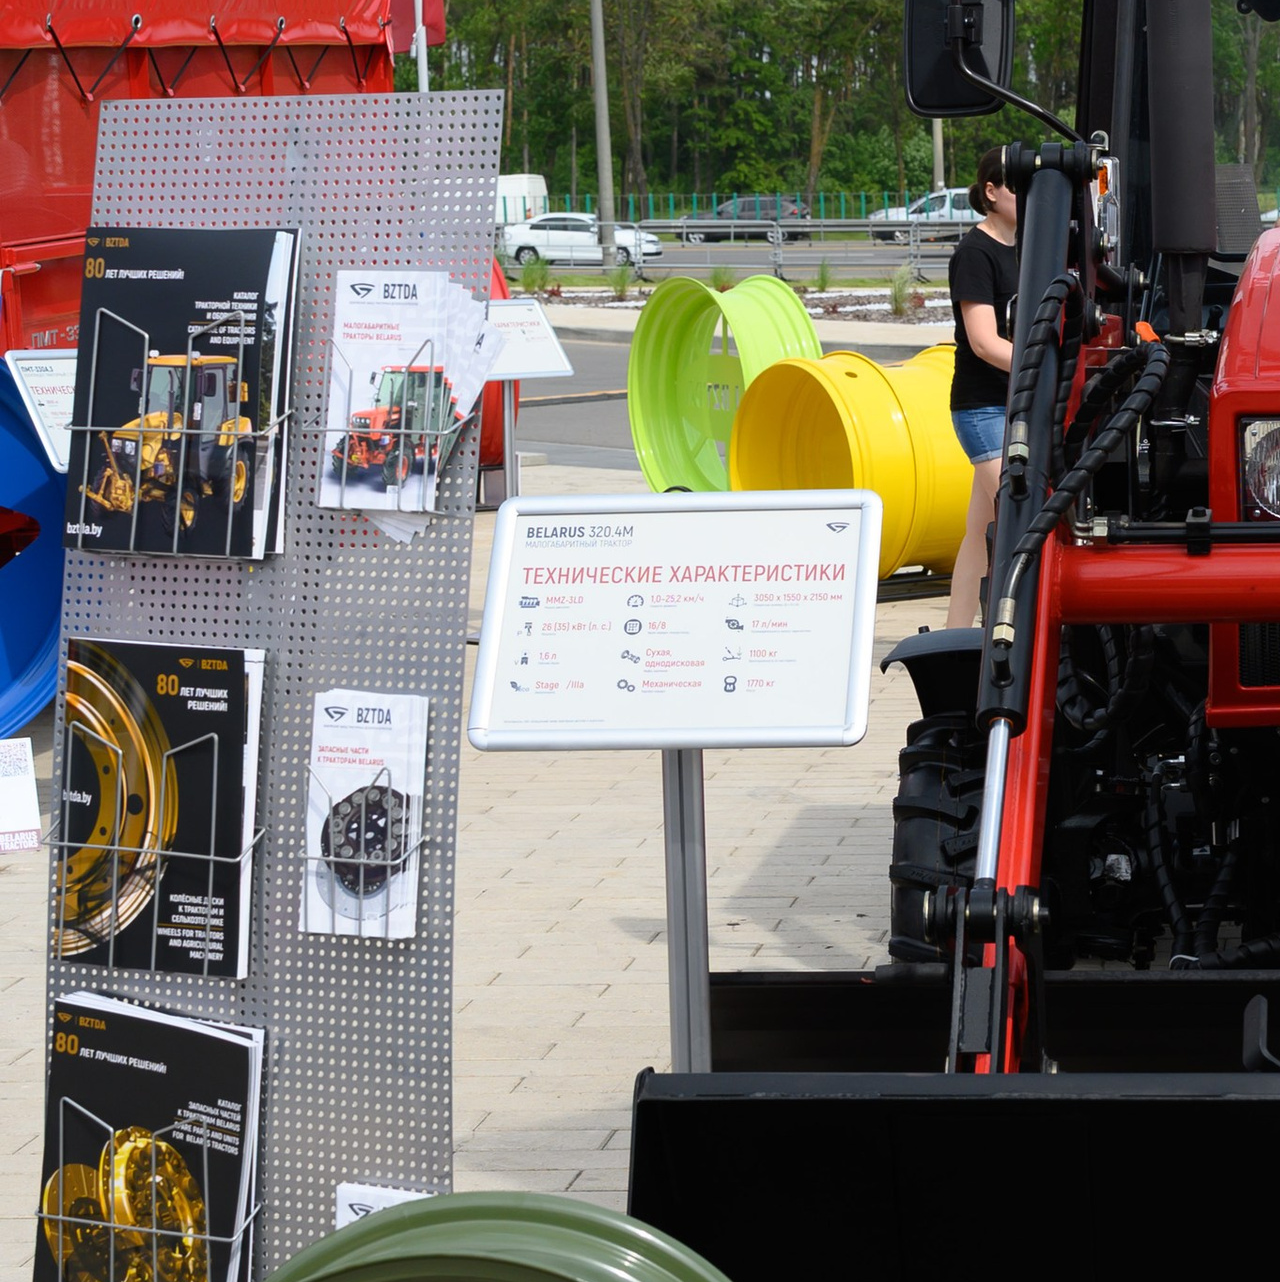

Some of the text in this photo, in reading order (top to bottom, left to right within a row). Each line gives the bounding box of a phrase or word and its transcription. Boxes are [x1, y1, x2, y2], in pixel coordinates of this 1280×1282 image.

[105, 238, 129, 247] BZTDA
[85, 258, 185, 280] 80 ЛЕТ ЛУЧШИХ РЕШЕНИЙ!
[383, 283, 418, 300] BZTDA
[227, 326, 256, 334] TRACORS
[343, 322, 400, 331] МАЛОГАБАРИТНЫЕ
[209, 336, 255, 344] AND EQUIPENT
[342, 332, 402, 342] ТРАКТОРЫ BELARUS
[527, 525, 634, 538] BELARUS 320.4M
[525, 539, 633, 548] МАЛОГАБАРИТНЫЙ ТРАКТОР
[523, 564, 845, 584] ТЕХНИЧЕСКИЕ ХАРАКТЕРИСТИКИ
[546, 596, 584, 604] MMZ-3LD
[684, 594, 704, 603] км/ч
[754, 593, 774, 602] 3050
[784, 593, 801, 602] 1550
[810, 593, 828, 601] 2150
[542, 623, 552, 631] 26
[554, 622, 569, 632] (35)
[572, 623, 586, 631] кВт
[648, 622, 666, 630] 16/8
[761, 620, 788, 629] л/мин
[539, 652, 550, 661] 1,6
[645, 648, 672, 659] Сухая,
[201, 659, 228, 670] BZTDA
[645, 660, 705, 668] однодисковая
[157, 674, 228, 698] 80 ЛЕТ ЛУЧШИХ
[535, 681, 559, 691] Stage
[642, 680, 701, 688] Механическая
[747, 679, 764, 687] 1770
[187, 700, 228, 712] РЕШЕНИЙ!
[357, 707, 391, 724] BZTDA
[318, 745, 348, 753] ЗАПАСНЫЕ
[322, 756, 356, 764] ТРАКТОРАМ
[358, 758, 384, 766] BELARUS
[203, 897, 224, 905] ДСКИ
[157, 928, 224, 940] WHEELS FOR TRATORS
[79, 1016, 106, 1030] BZTDA
[55, 1032, 167, 1074] 80 ЛЕТ ЛУЧШИХ РЕШЕНИЙ!
[188, 1101, 219, 1115] ЗАПАСНЫХ
[217, 1099, 242, 1111] КАТАЛОГ
[216, 1119, 240, 1132] BELARUS
[193, 1126, 239, 1145] PARS AND UNITS
[172, 1131, 238, 1155] FOR BELARS TRACTORS
